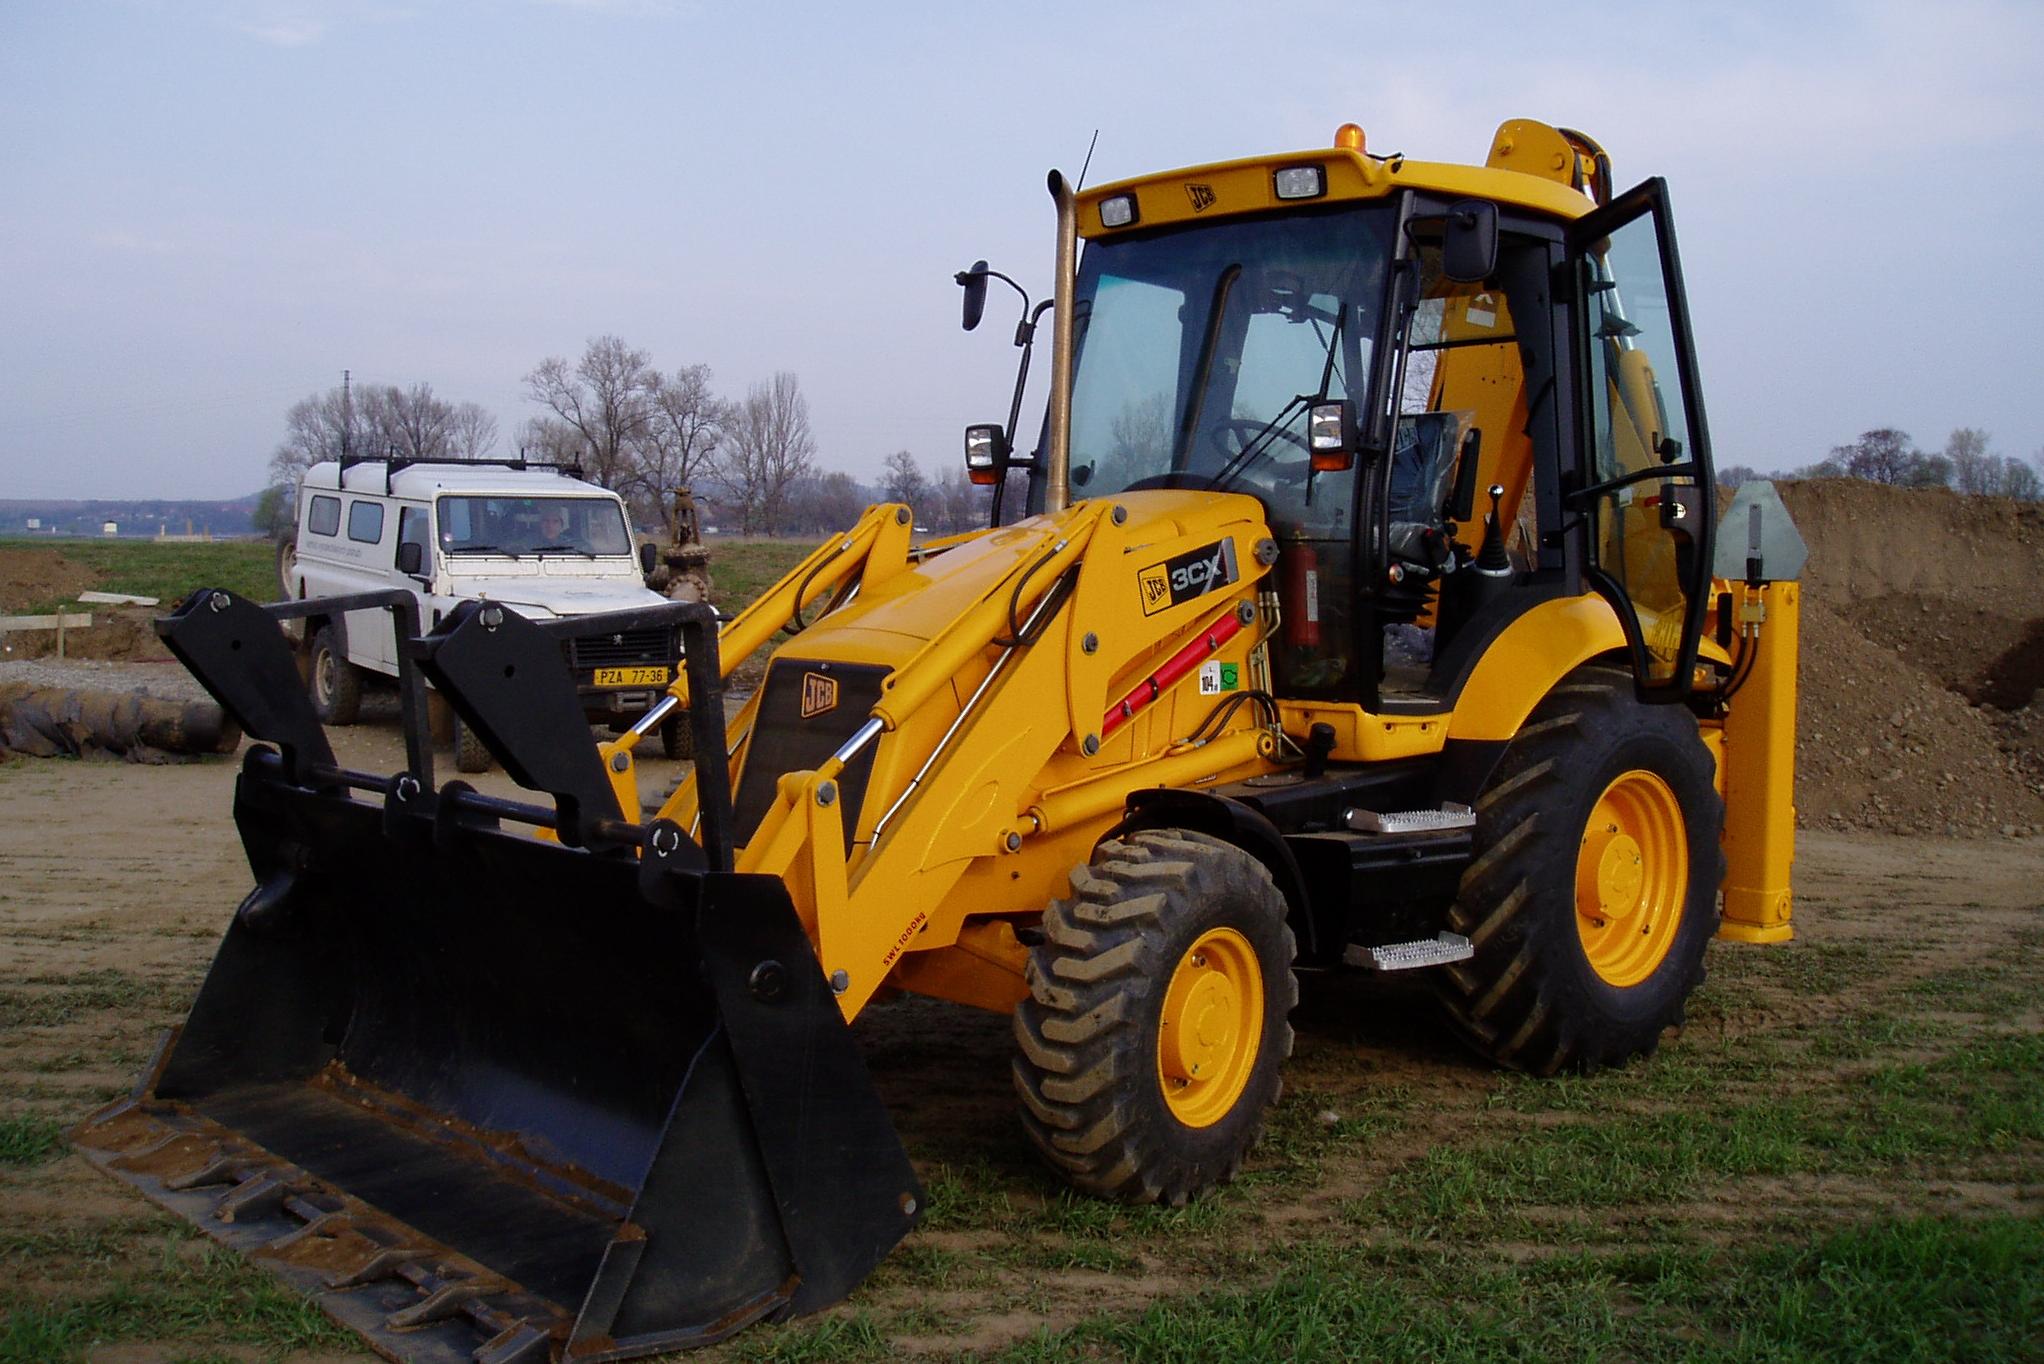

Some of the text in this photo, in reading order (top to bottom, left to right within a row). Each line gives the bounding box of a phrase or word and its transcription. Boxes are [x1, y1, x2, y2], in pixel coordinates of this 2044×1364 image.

[1189, 186, 1214, 210] JCB
[1171, 555, 1222, 591] 3CX
[1145, 577, 1168, 602] JCB
[600, 669, 664, 684] PZA 77-36
[804, 677, 833, 713] JCB
[883, 945, 900, 966] SWL
